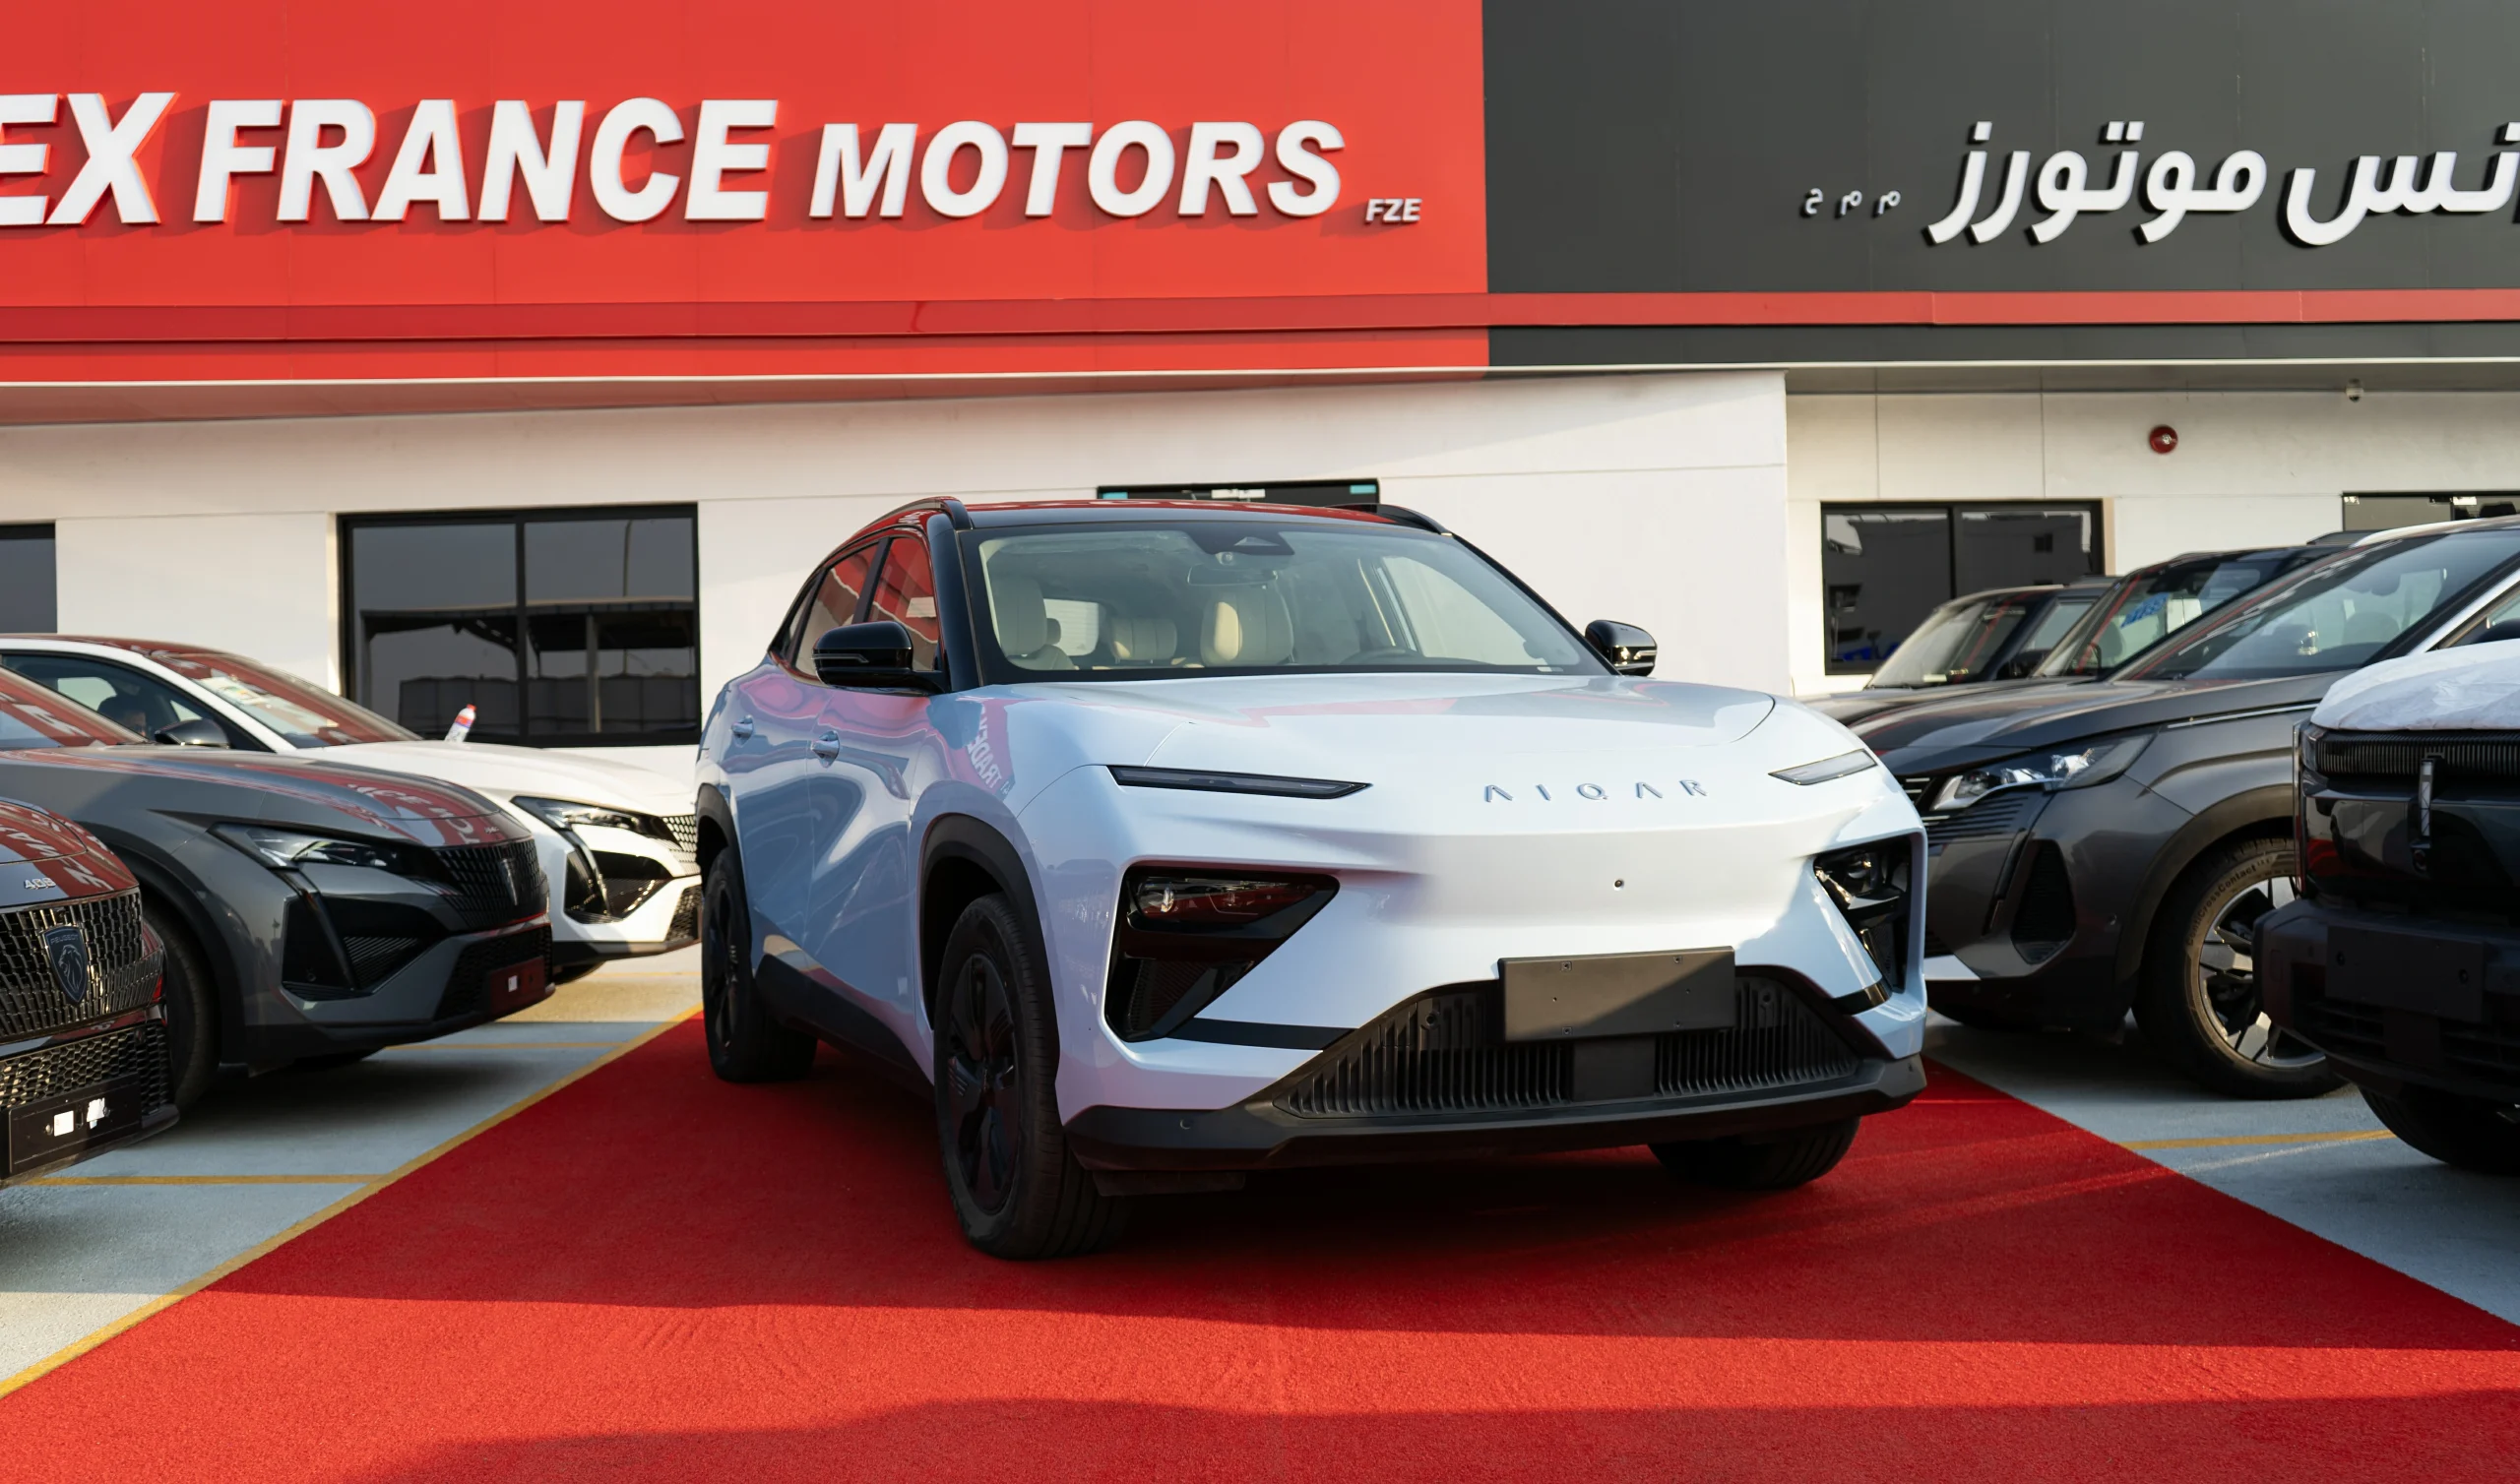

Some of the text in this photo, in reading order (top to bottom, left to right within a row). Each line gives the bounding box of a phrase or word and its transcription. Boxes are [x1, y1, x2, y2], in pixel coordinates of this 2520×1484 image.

[0, 93, 1421, 224] EX FRANCE MOTORS FZE
[1928, 120, 2266, 243] موتورز
[1483, 779, 1708, 803] AIQAR
